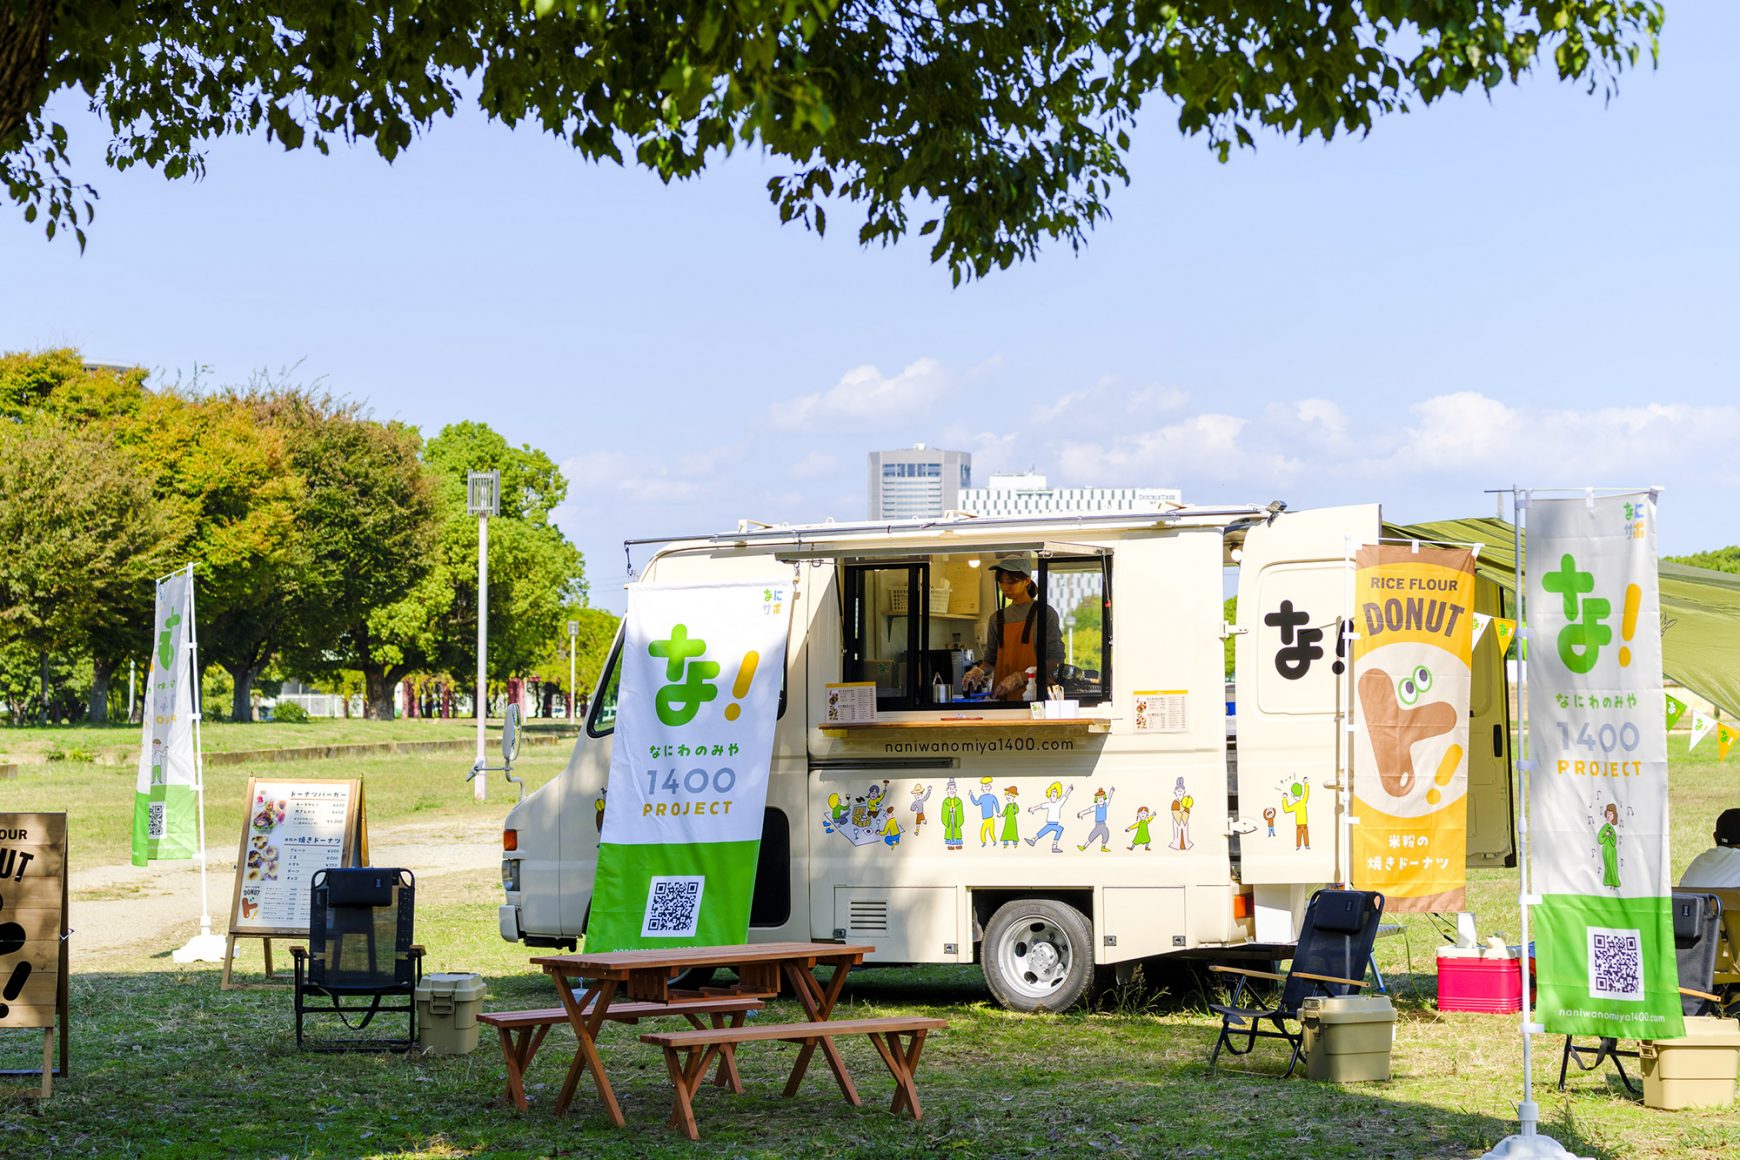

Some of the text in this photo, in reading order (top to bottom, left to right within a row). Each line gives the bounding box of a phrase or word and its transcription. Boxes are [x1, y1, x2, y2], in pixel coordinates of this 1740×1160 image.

[1623, 502, 1644, 521] なに
[1371, 577, 1458, 591] RICE FLOUR
[763, 588, 783, 602] なに
[1362, 597, 1465, 638] DONUT
[1556, 693, 1638, 709] なにわのみや
[1556, 721, 1640, 753] 1400
[649, 743, 740, 759] なにわのみや
[885, 737, 1074, 755] naniwanomiya1400.com
[1557, 759, 1643, 777] PROJECT
[646, 767, 737, 796] 1400
[642, 800, 733, 817] PROJECT
[1388, 834, 1429, 848] 米粉の
[1367, 856, 1449, 872] 焼きドーナツ
[1558, 1008, 1665, 1023] naniwanomiya1400.com
